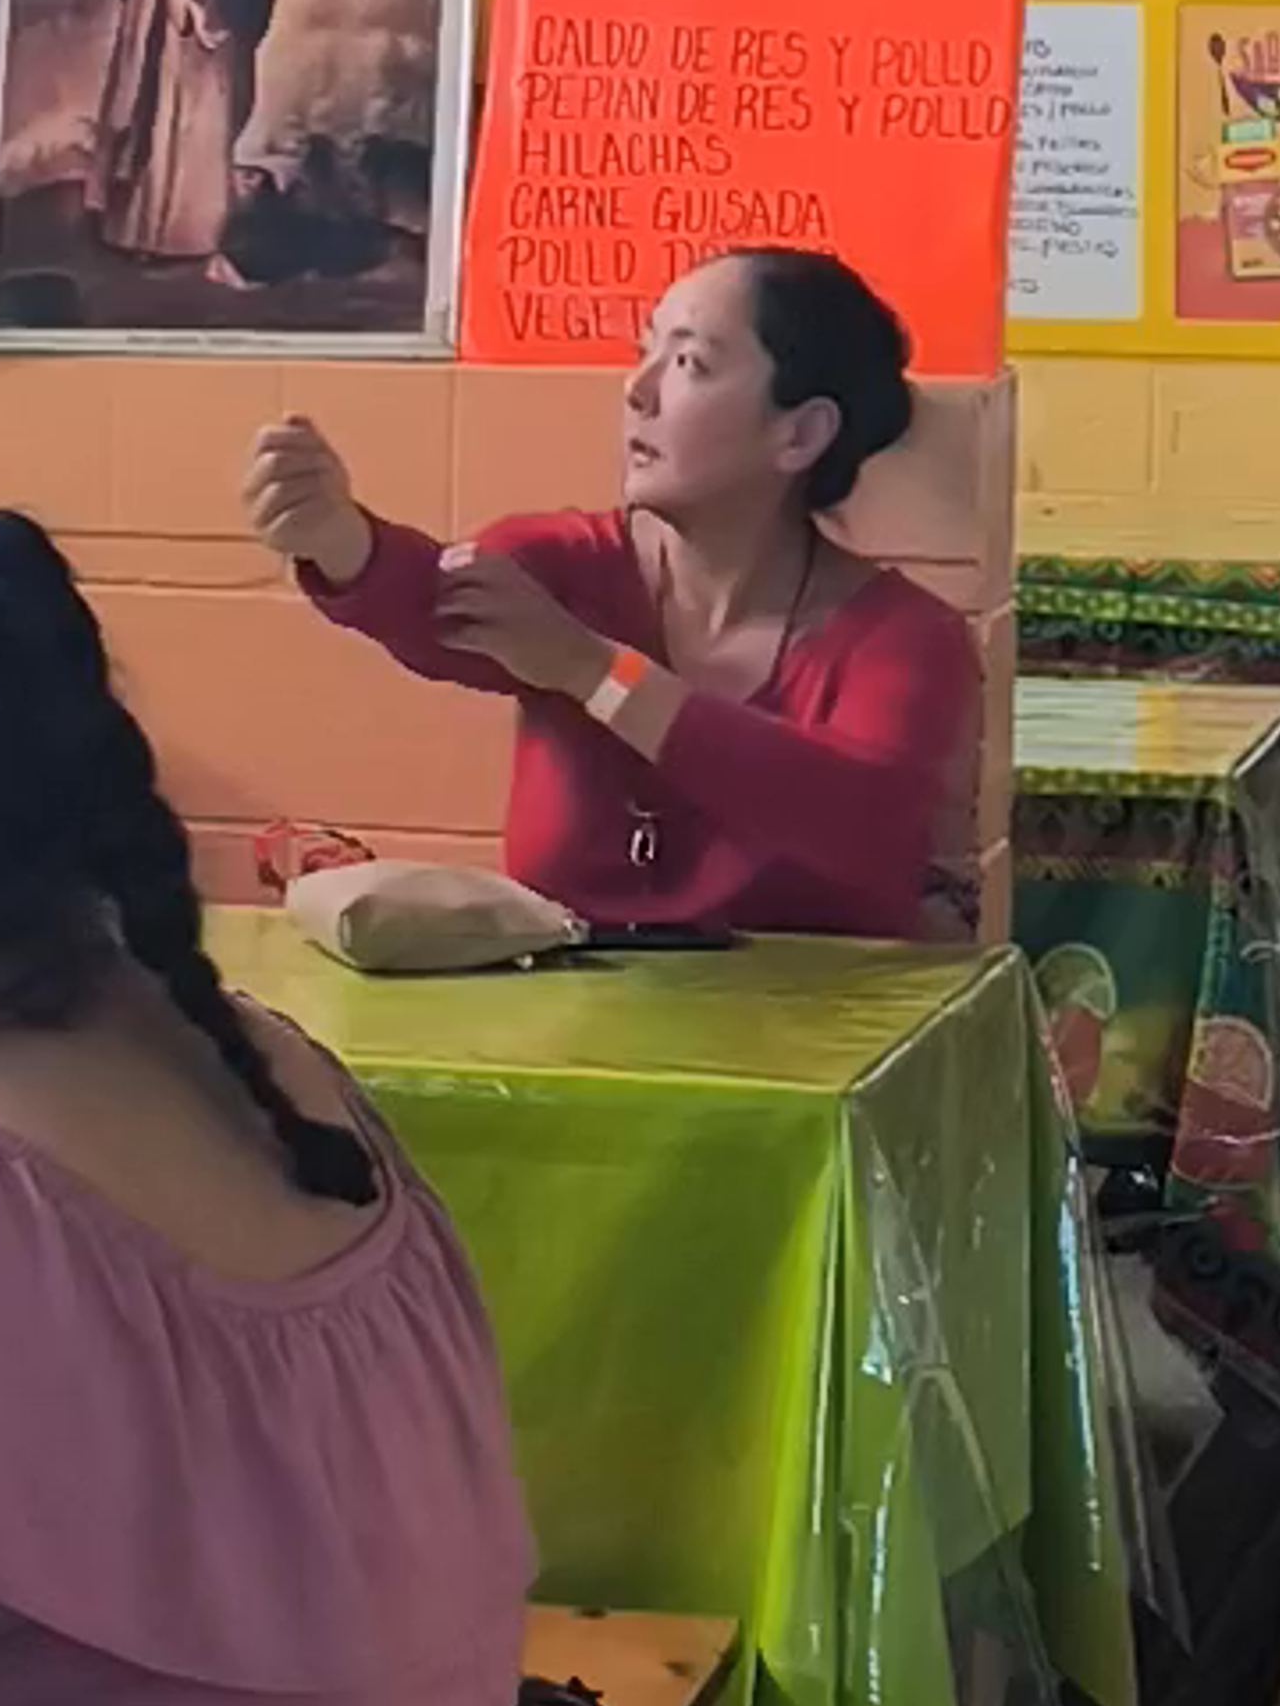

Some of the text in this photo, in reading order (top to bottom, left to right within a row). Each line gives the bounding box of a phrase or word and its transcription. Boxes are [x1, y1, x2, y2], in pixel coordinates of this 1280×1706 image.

[532, 14, 648, 68] CALDO
[670, 24, 717, 74] DE
[731, 26, 809, 80] RES
[829, 35, 852, 86] Y
[871, 37, 992, 87] POLLO
[520, 72, 1011, 141] PEPIAN DE RES Y POLLO
[520, 130, 732, 179] HILACHAS
[510, 183, 827, 238] CARNE GUISADA
[497, 236, 637, 287] POLLO
[503, 290, 650, 340] VEGET
